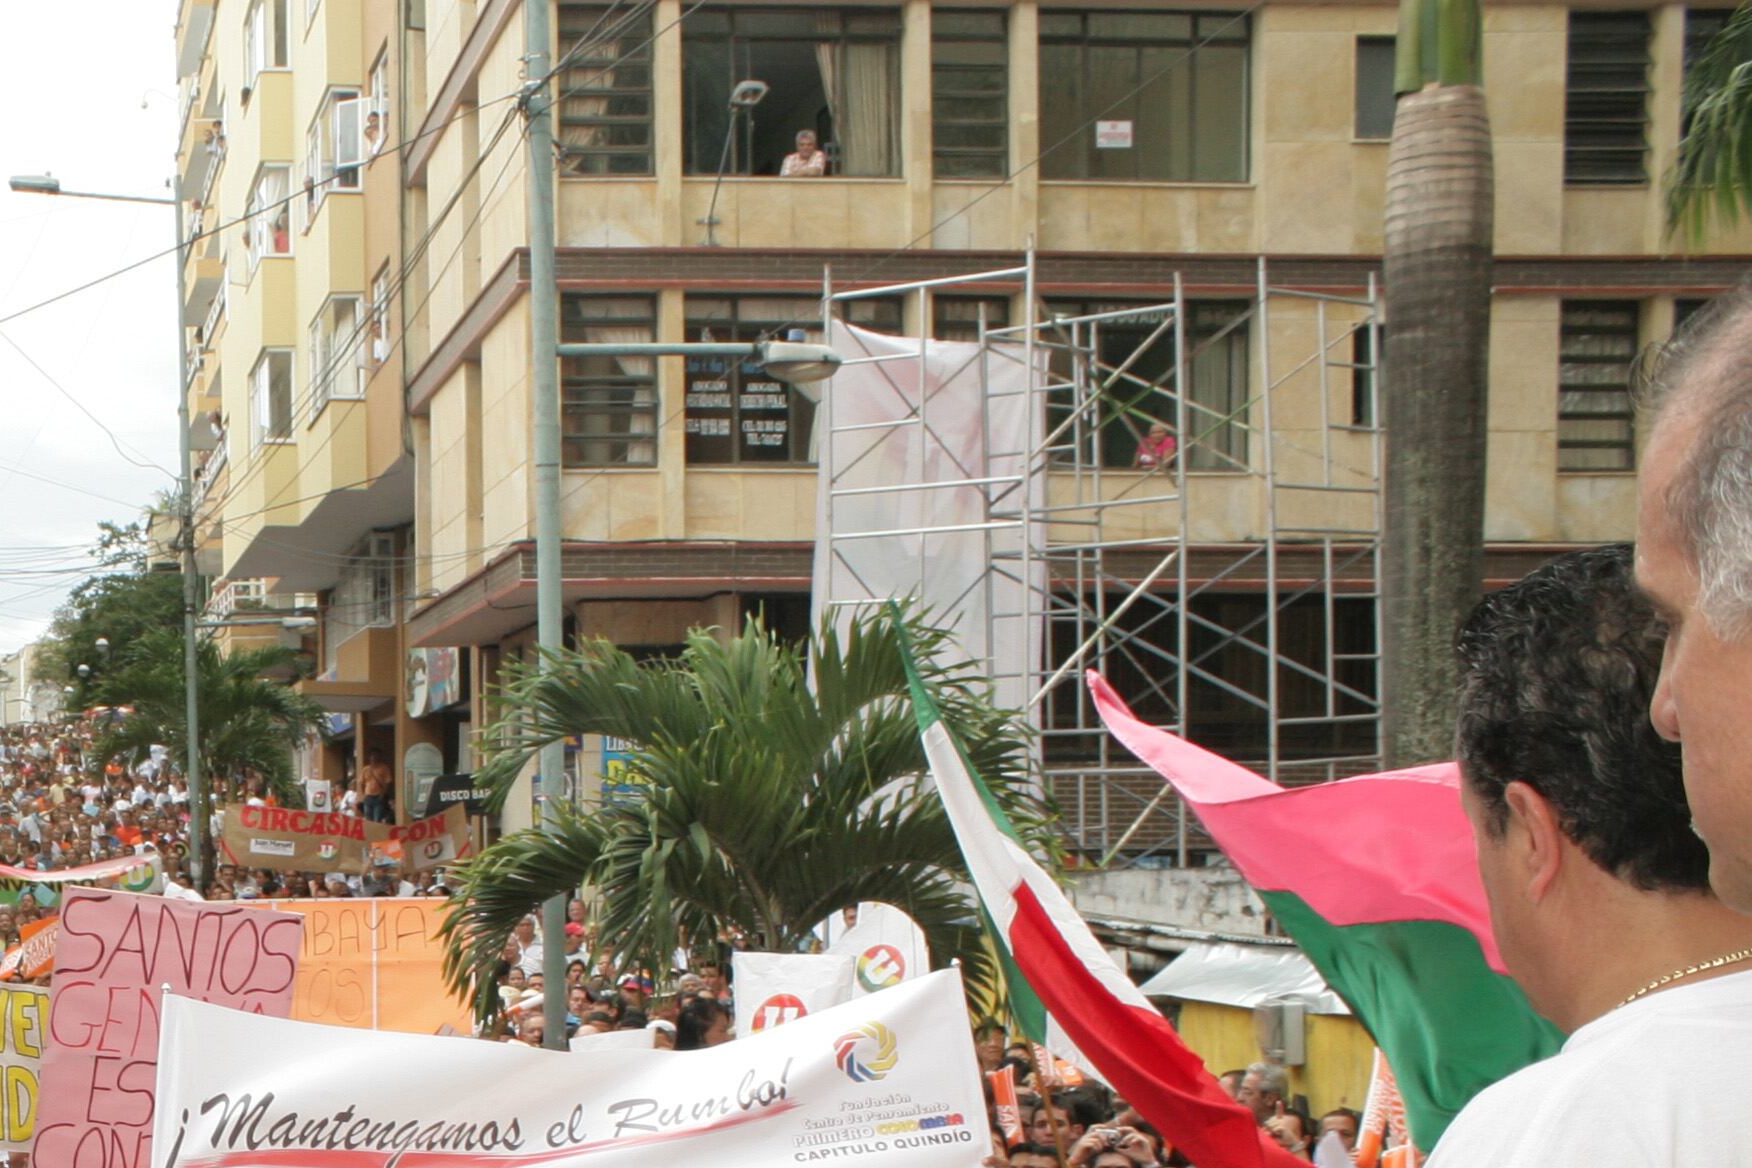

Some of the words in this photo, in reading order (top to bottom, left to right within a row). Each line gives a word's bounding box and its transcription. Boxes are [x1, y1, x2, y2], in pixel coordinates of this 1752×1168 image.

[440, 789, 469, 801] DISCO
[240, 804, 367, 841] CIRCASIA
[388, 814, 447, 844] CON
[55, 895, 301, 996] SANTOS
[303, 905, 428, 957] BAYA
[545, 1102, 586, 1149] el
[607, 1055, 794, 1139] Rumbo!
[848, 1112, 863, 1125] de
[865, 1102, 950, 1123] Pensamiento
[792, 1125, 876, 1148] PRIMERO
[794, 1141, 889, 1163] CAPITULO
[893, 1128, 972, 1150] QUINDÍO
